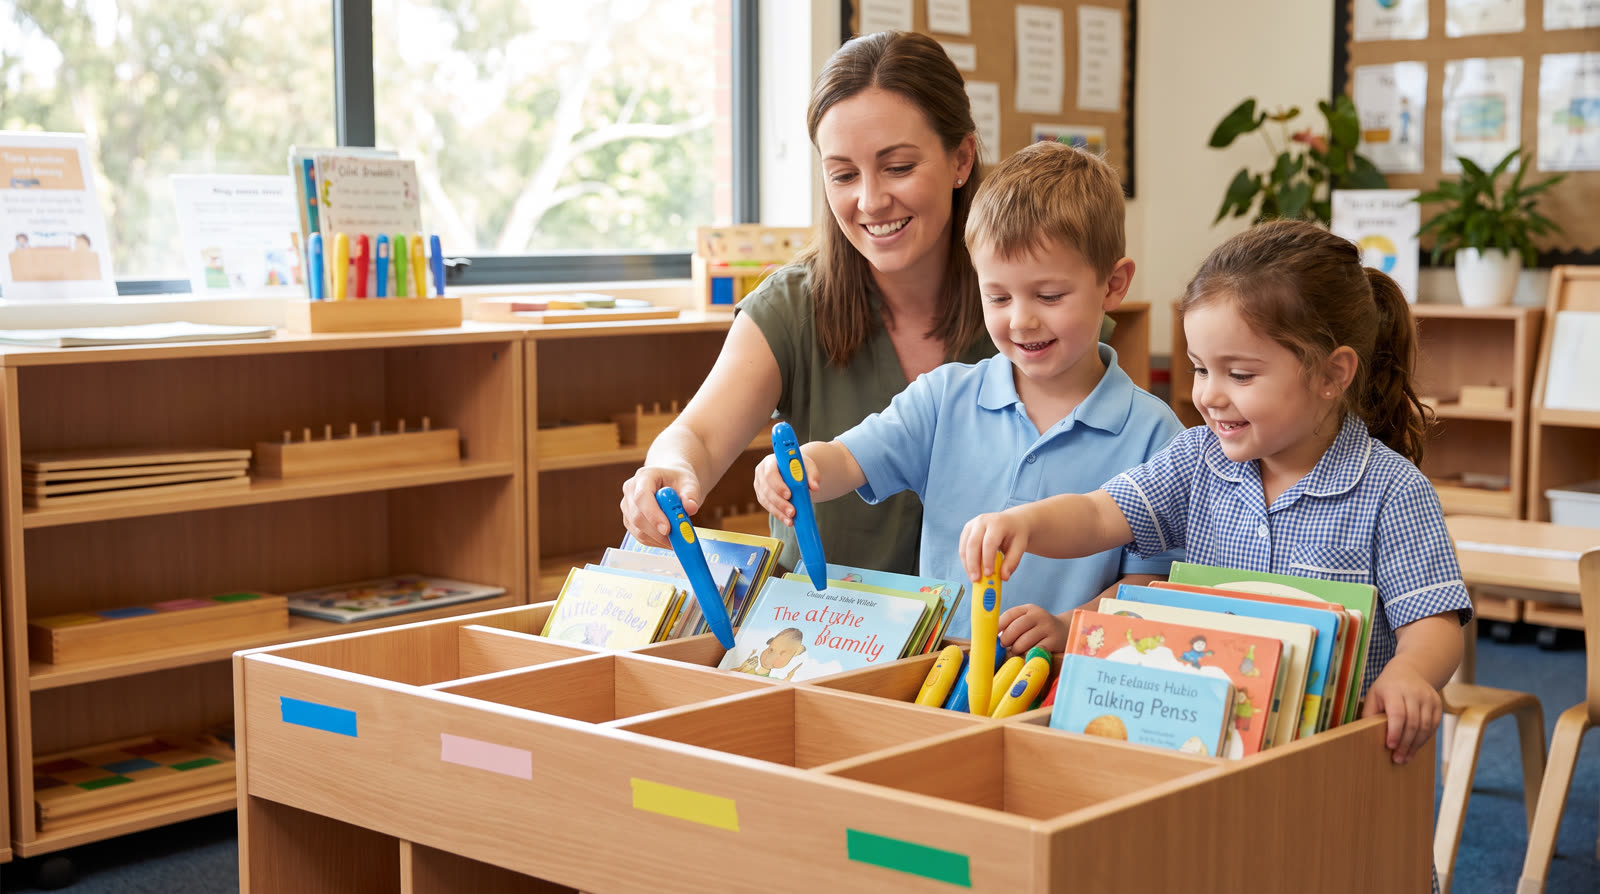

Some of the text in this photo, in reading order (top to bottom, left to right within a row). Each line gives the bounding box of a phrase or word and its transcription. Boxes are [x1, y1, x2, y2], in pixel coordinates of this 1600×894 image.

[773, 606, 800, 621] The
[1097, 670, 1117, 685] The
[1087, 687, 1198, 723] Talking Penss
